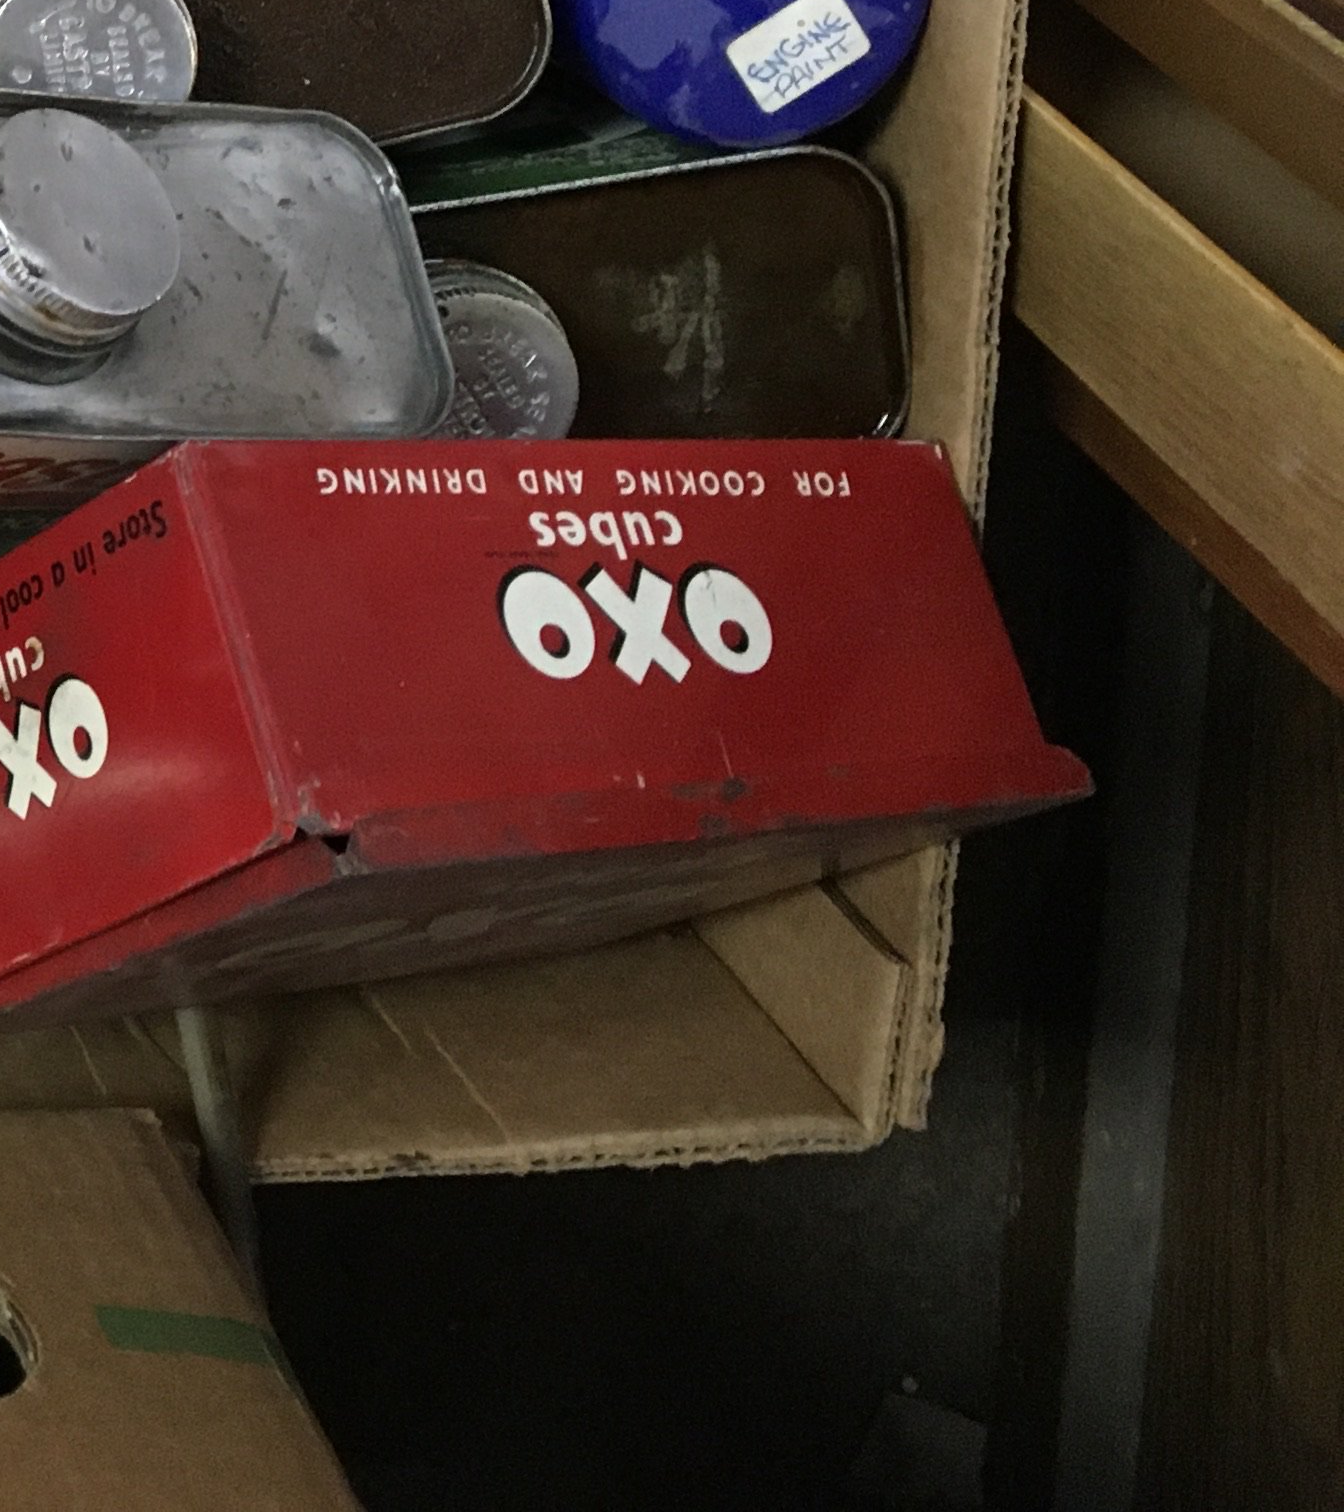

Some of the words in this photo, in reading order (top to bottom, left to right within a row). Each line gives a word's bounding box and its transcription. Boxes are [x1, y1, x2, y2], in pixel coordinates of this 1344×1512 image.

[747, 12, 851, 83] ENGINE
[773, 34, 848, 99] PAINT
[316, 468, 487, 496] DRINKING
[518, 468, 584, 495] AND
[617, 468, 765, 497] COOKING
[792, 469, 852, 498] FOR
[101, 499, 168, 556] Store
[528, 510, 683, 561] cubes
[50, 560, 66, 587] a
[72, 541, 98, 576] in
[0, 573, 44, 630] cool
[497, 562, 773, 686] OXO
